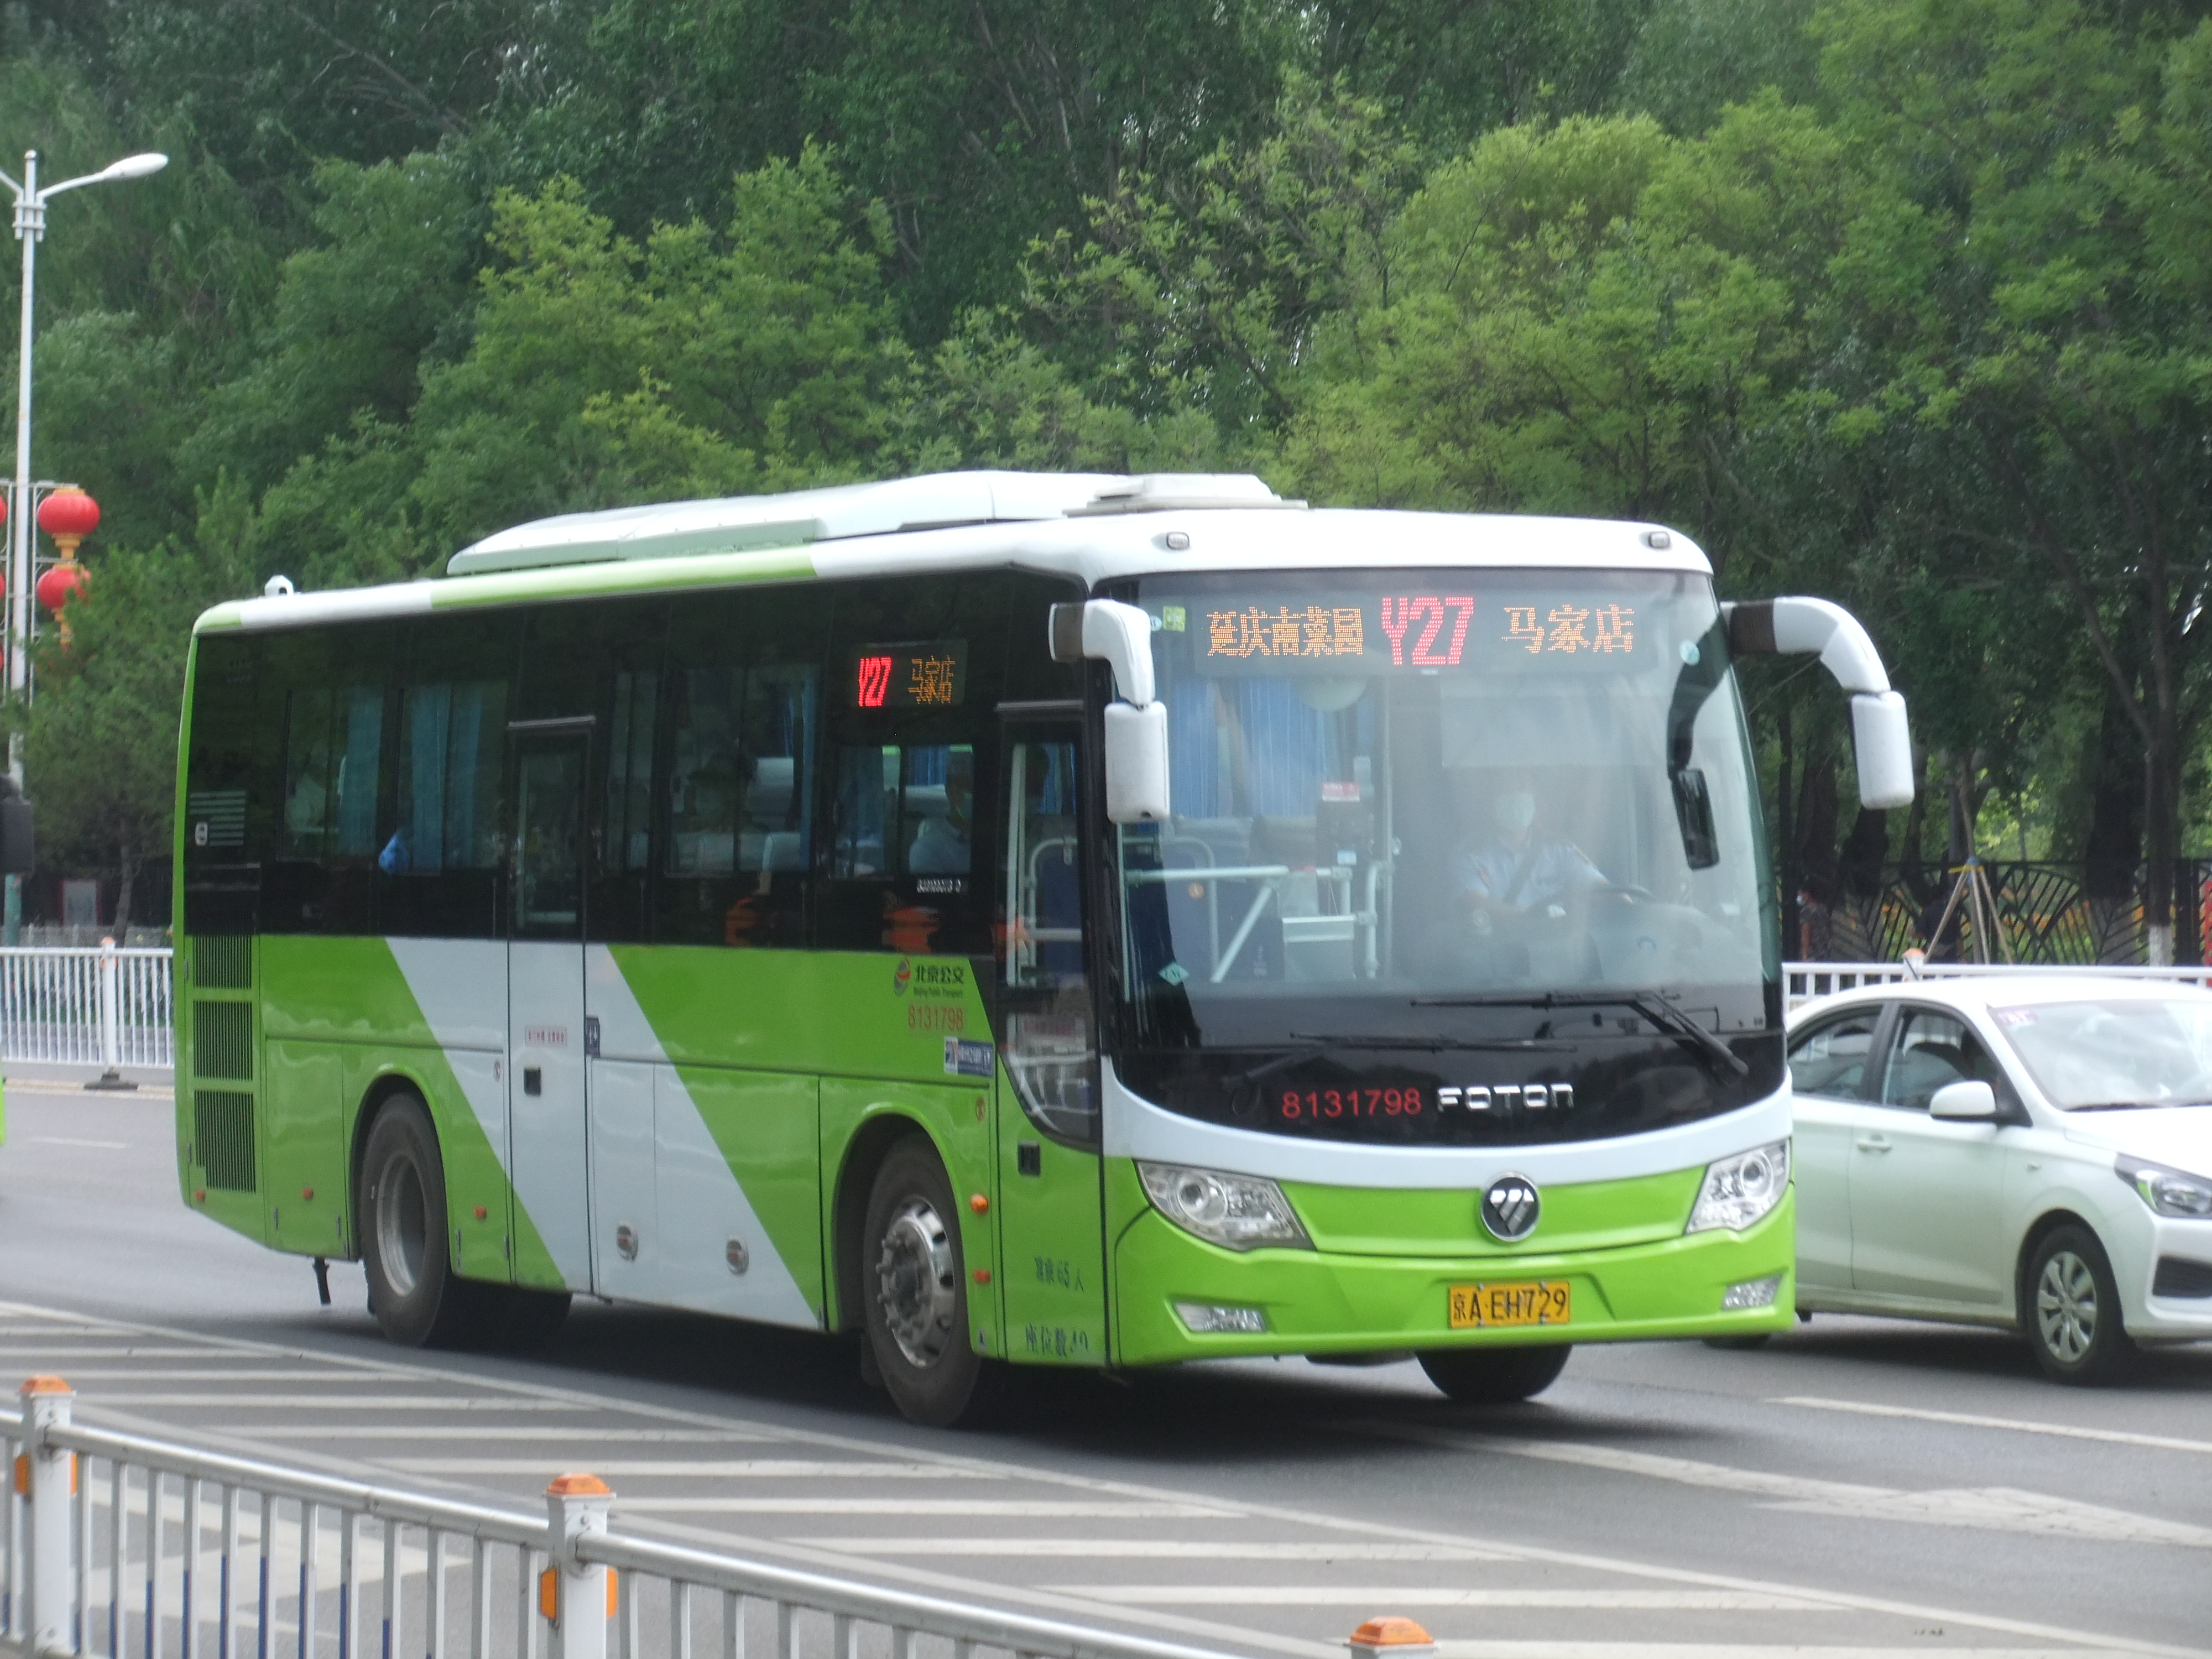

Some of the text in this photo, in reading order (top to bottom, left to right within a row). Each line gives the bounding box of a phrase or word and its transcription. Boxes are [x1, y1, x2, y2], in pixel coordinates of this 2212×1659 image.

[1207, 597, 1635, 665] 延庆南菜园 Y27 马家店
[858, 655, 956, 707] Y27 马家店
[916, 963, 964, 984] 北京公交
[908, 1004, 963, 1032] 8131798
[1282, 1087, 1422, 1119] 8131798
[1437, 1082, 1574, 1112] FOTON
